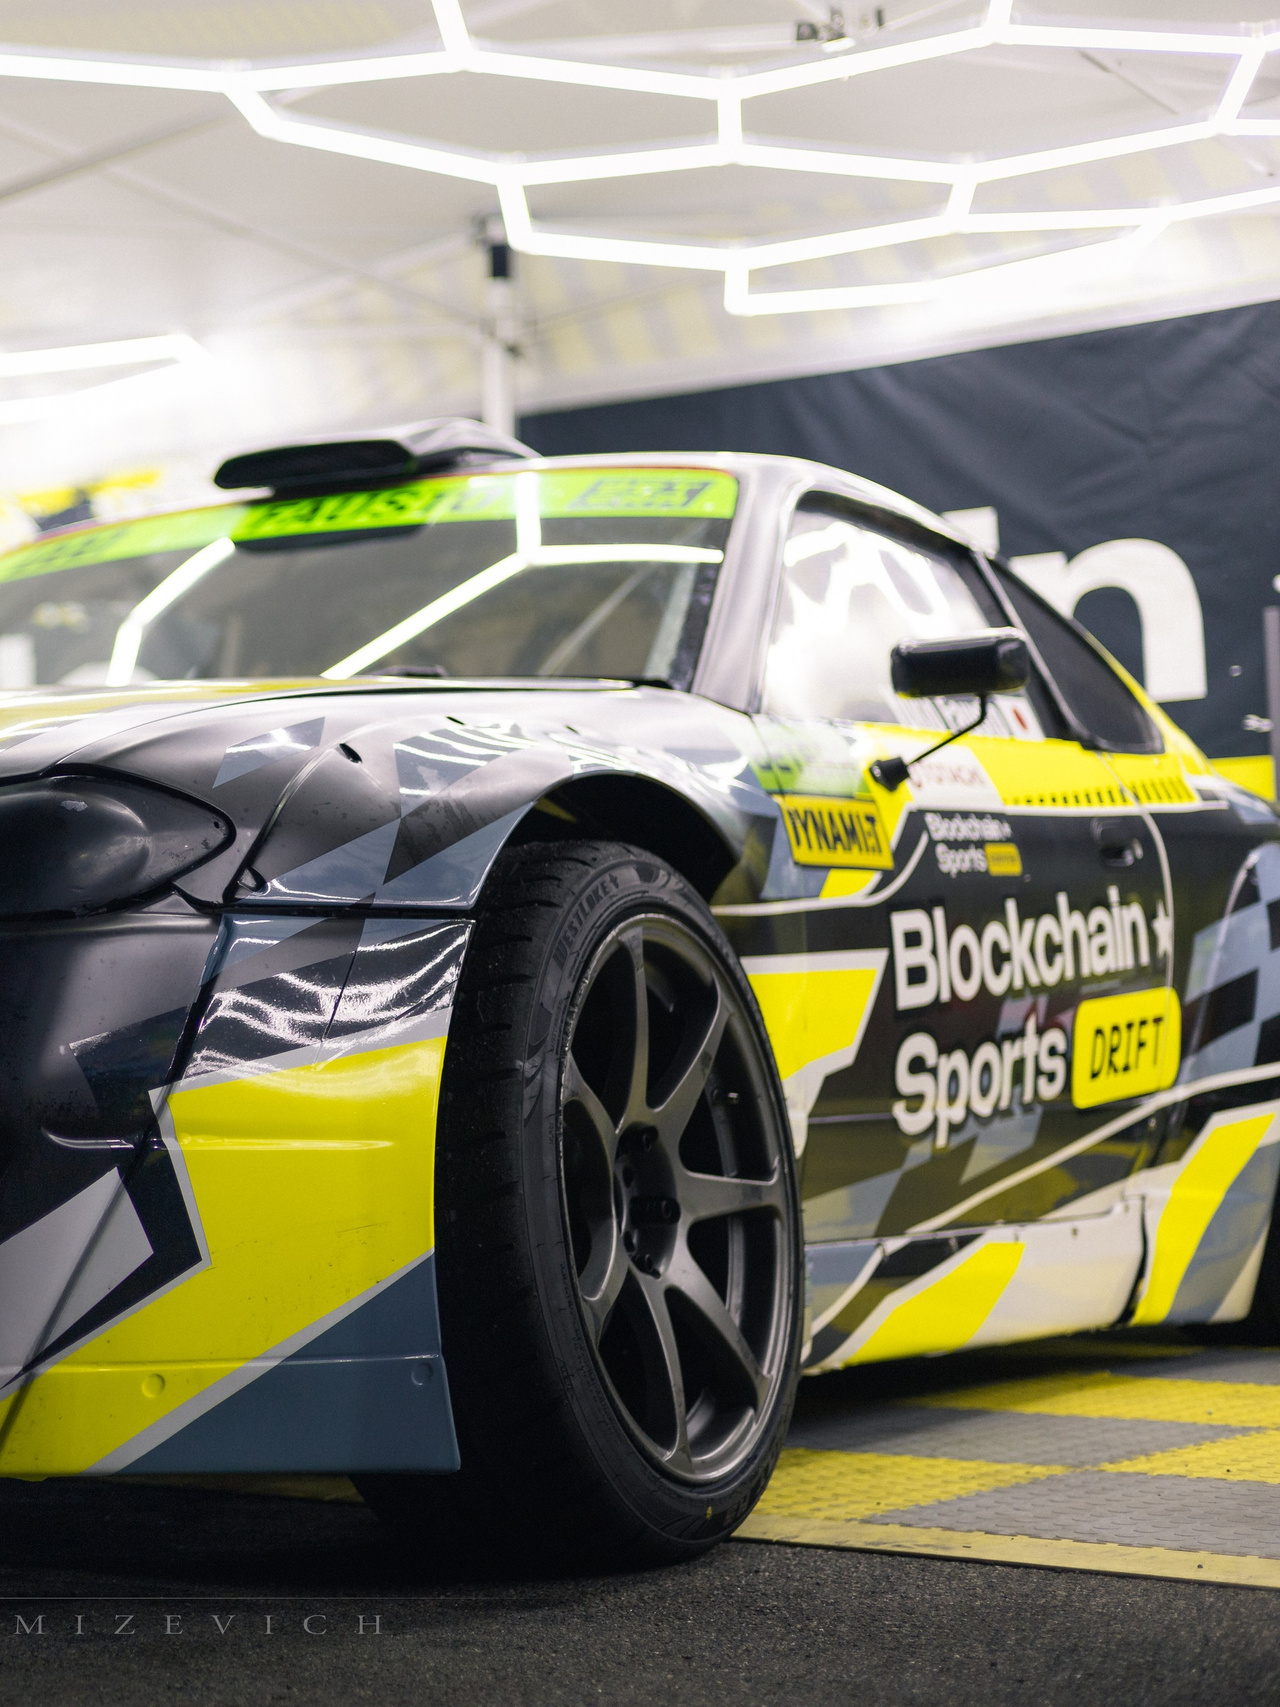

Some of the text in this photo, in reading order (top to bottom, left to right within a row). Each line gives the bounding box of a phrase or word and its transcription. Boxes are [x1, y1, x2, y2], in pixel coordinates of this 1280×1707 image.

[935, 842, 987, 879] Sports
[890, 886, 1150, 1011] Blockchain
[892, 1015, 1165, 1148] Sports DRIFT
